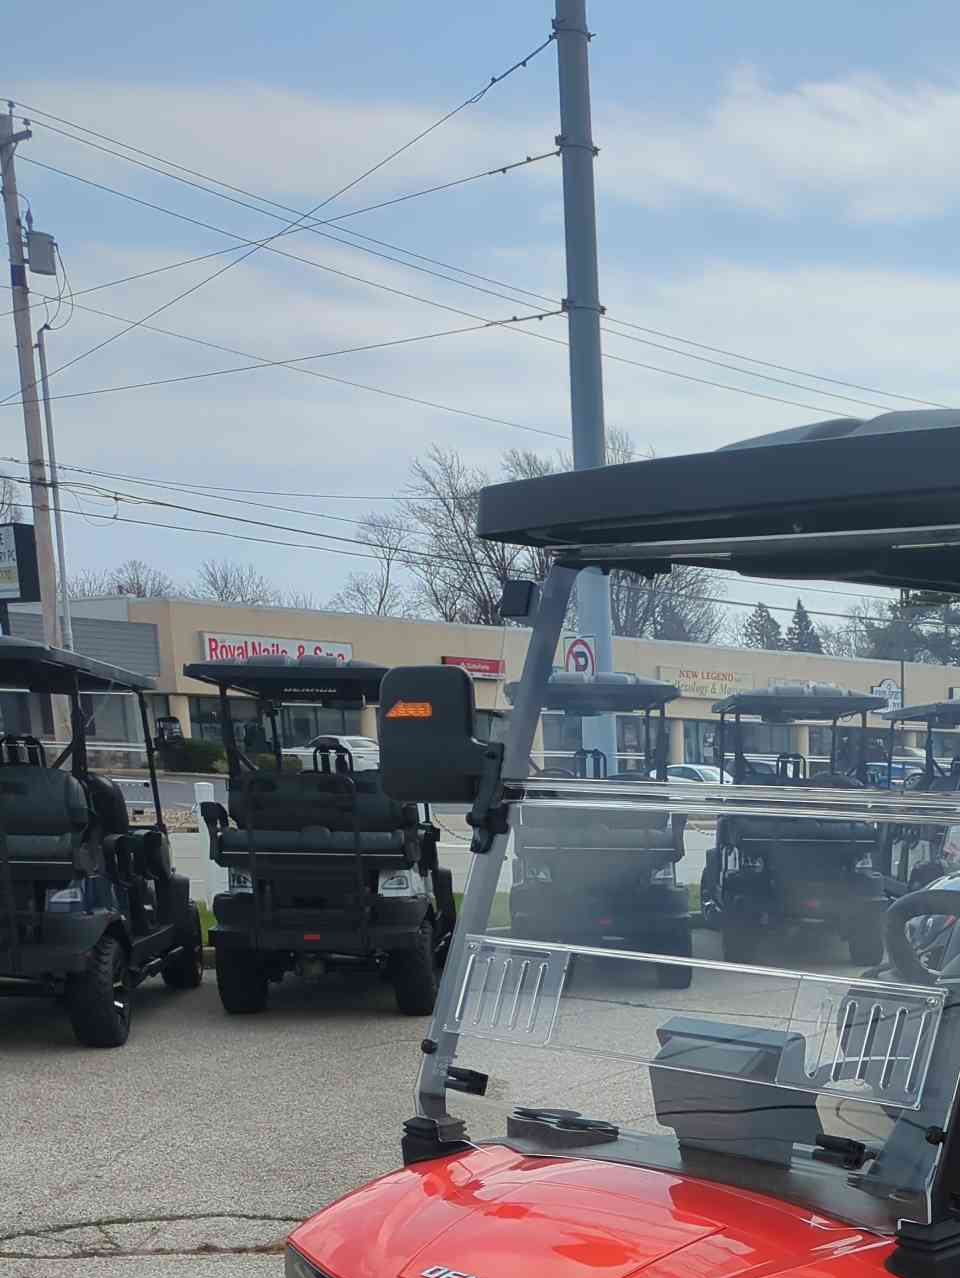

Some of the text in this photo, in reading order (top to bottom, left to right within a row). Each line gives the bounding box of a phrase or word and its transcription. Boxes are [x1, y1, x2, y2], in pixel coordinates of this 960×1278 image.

[208, 637, 248, 662] Royal
[314, 644, 346, 662] Sa
[679, 671, 734, 682] NEW LEGEND
